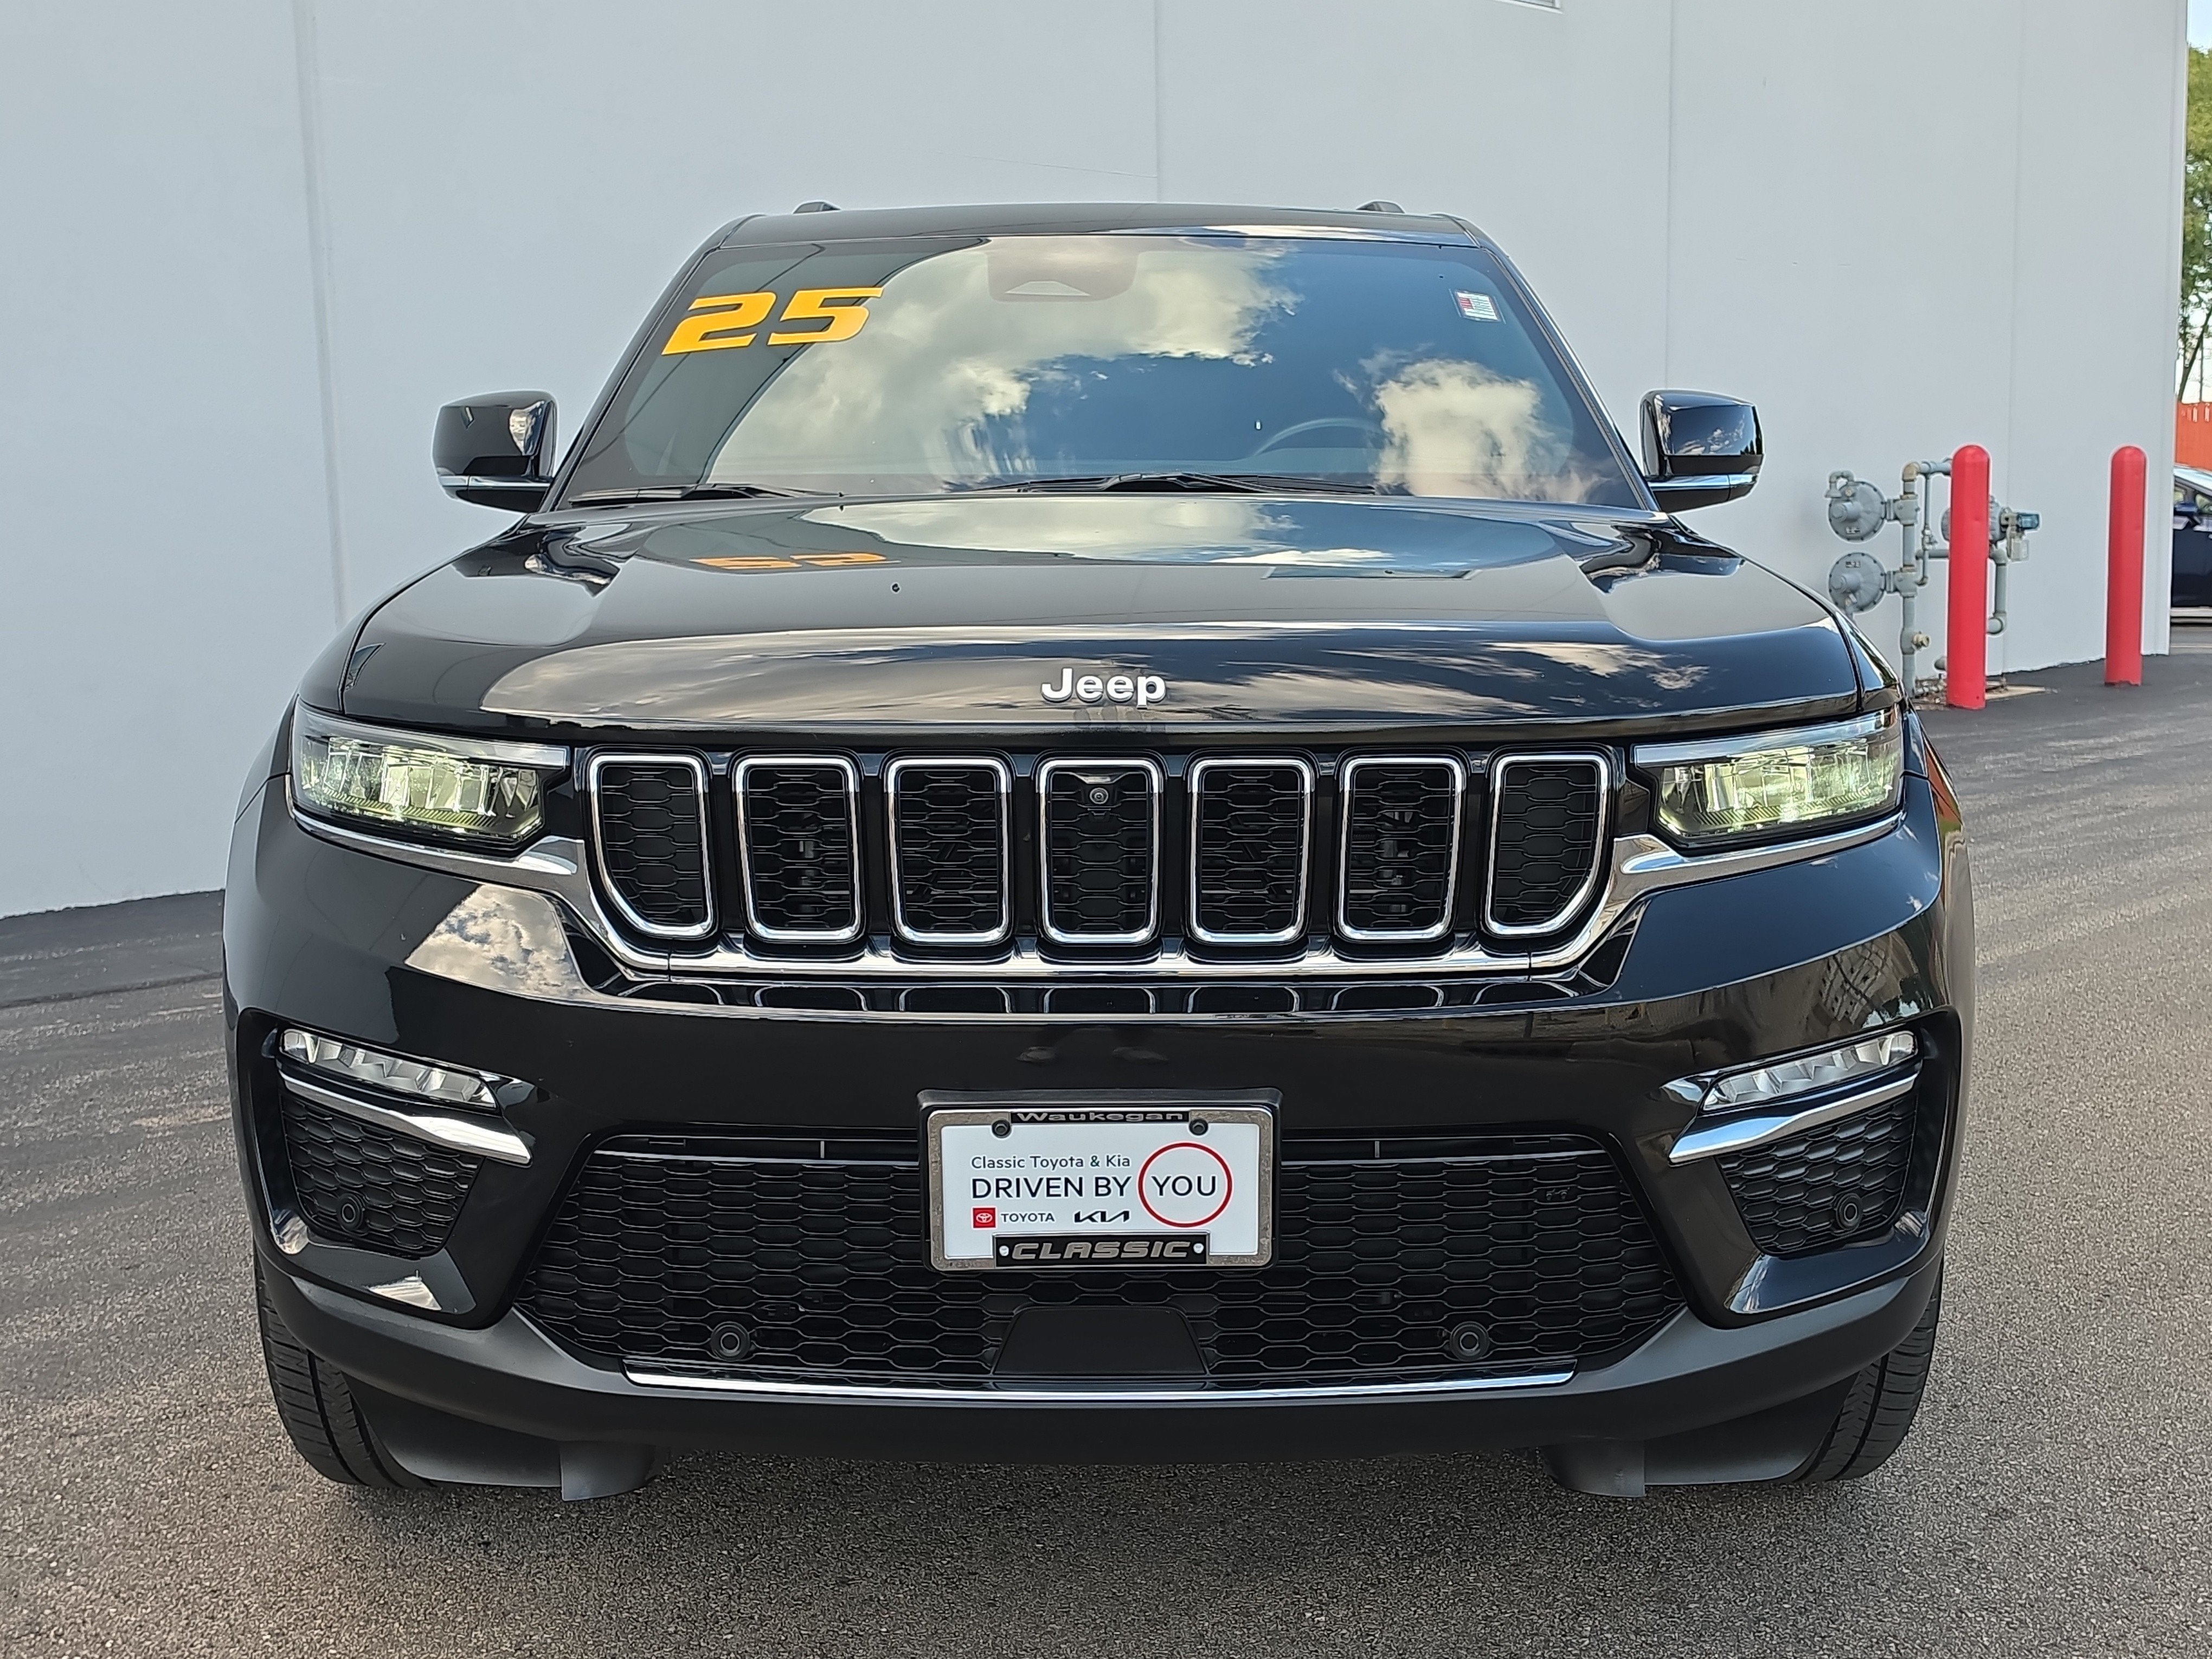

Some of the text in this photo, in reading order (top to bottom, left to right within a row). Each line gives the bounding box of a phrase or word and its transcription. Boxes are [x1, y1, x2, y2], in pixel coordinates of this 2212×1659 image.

[661, 286, 884, 356] 25
[1041, 667, 1166, 709] Jeep
[1017, 1112, 1183, 1122] Waukegan
[971, 1154, 1130, 1171] Classic Toyota & Kia
[972, 1175, 1217, 1199] DRIVEN BY YOU
[1000, 1212, 1055, 1223] TOYOTA
[1073, 1210, 1130, 1223] KIA
[1012, 1241, 1191, 1260] CLASSIC
